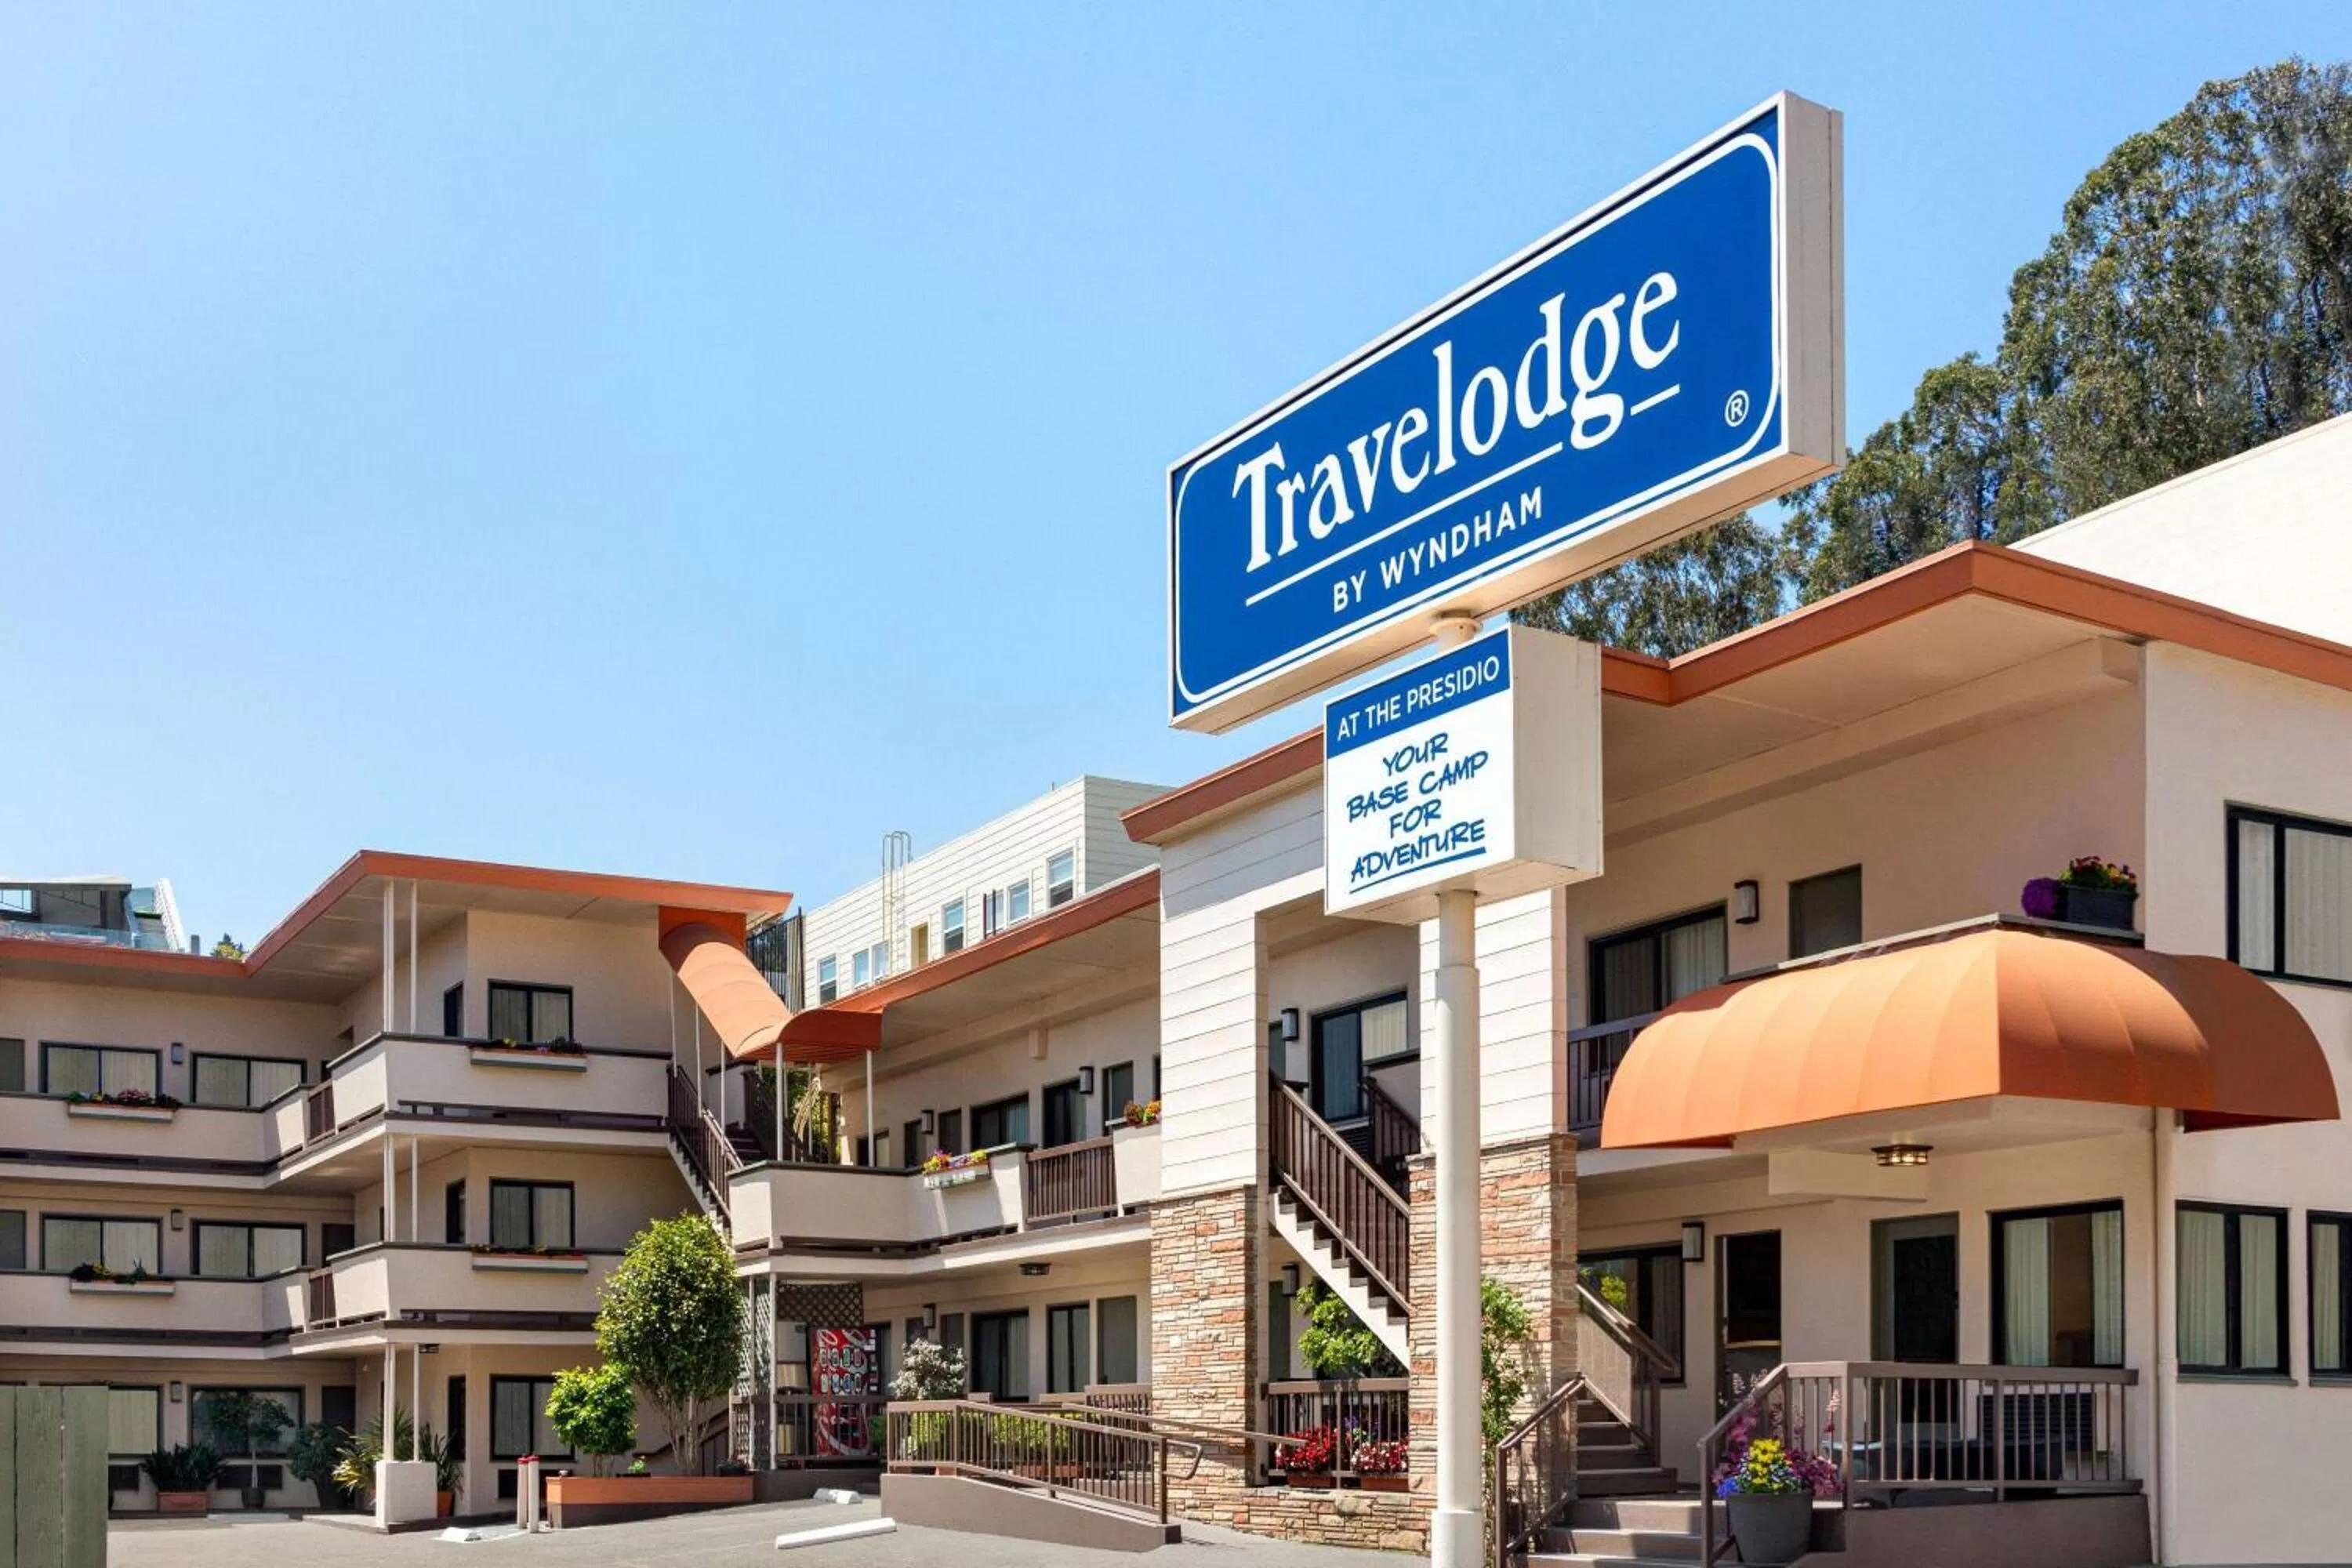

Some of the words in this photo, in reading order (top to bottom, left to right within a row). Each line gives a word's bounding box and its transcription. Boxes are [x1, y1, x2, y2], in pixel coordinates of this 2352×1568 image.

[1232, 271, 1680, 573] Travelodge
[1334, 569, 1366, 614] BY
[1381, 486, 1543, 590] WYNDHAM
[1337, 711, 1360, 742] AT
[1365, 694, 1401, 729] THE
[1406, 655, 1500, 714] PRESIDIO
[1346, 781, 1408, 823] BASE
[1418, 750, 1489, 796] CAMP
[1382, 731, 1449, 777] YOUR
[1351, 818, 1486, 884] ADVENTURE
[1389, 799, 1442, 839] FOR
